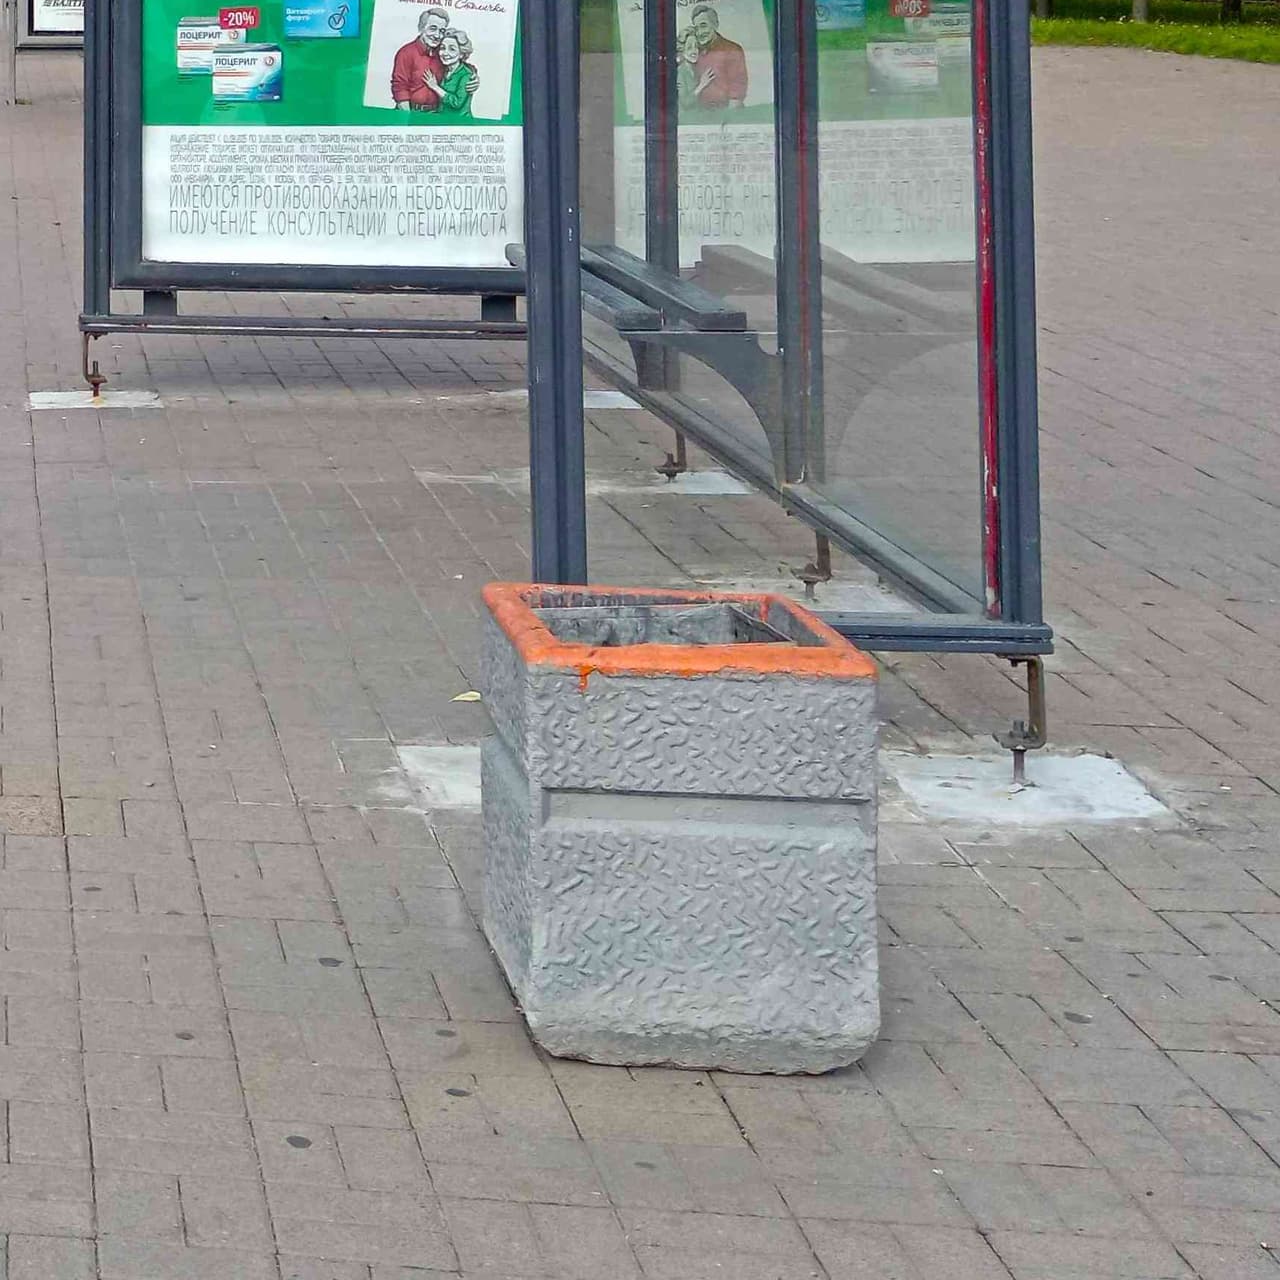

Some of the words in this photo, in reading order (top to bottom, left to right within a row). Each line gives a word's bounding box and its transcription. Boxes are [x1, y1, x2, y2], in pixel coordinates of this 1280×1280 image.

[222, 12, 256, 27] -20%
[179, 31, 222, 40] ЛОЦЕРИЛ
[215, 57, 257, 67] ЛОЦЕРИЛ
[169, 184, 239, 209] ИМЕЮТСЯ
[405, 185, 508, 212] НЕОБХОДИМО
[169, 210, 258, 236] ПОЛУЧЕНИЕ
[267, 211, 388, 240] КОНСУЛЬТАЦИИ
[396, 212, 508, 240] СПЕЦИАЛИСТА
